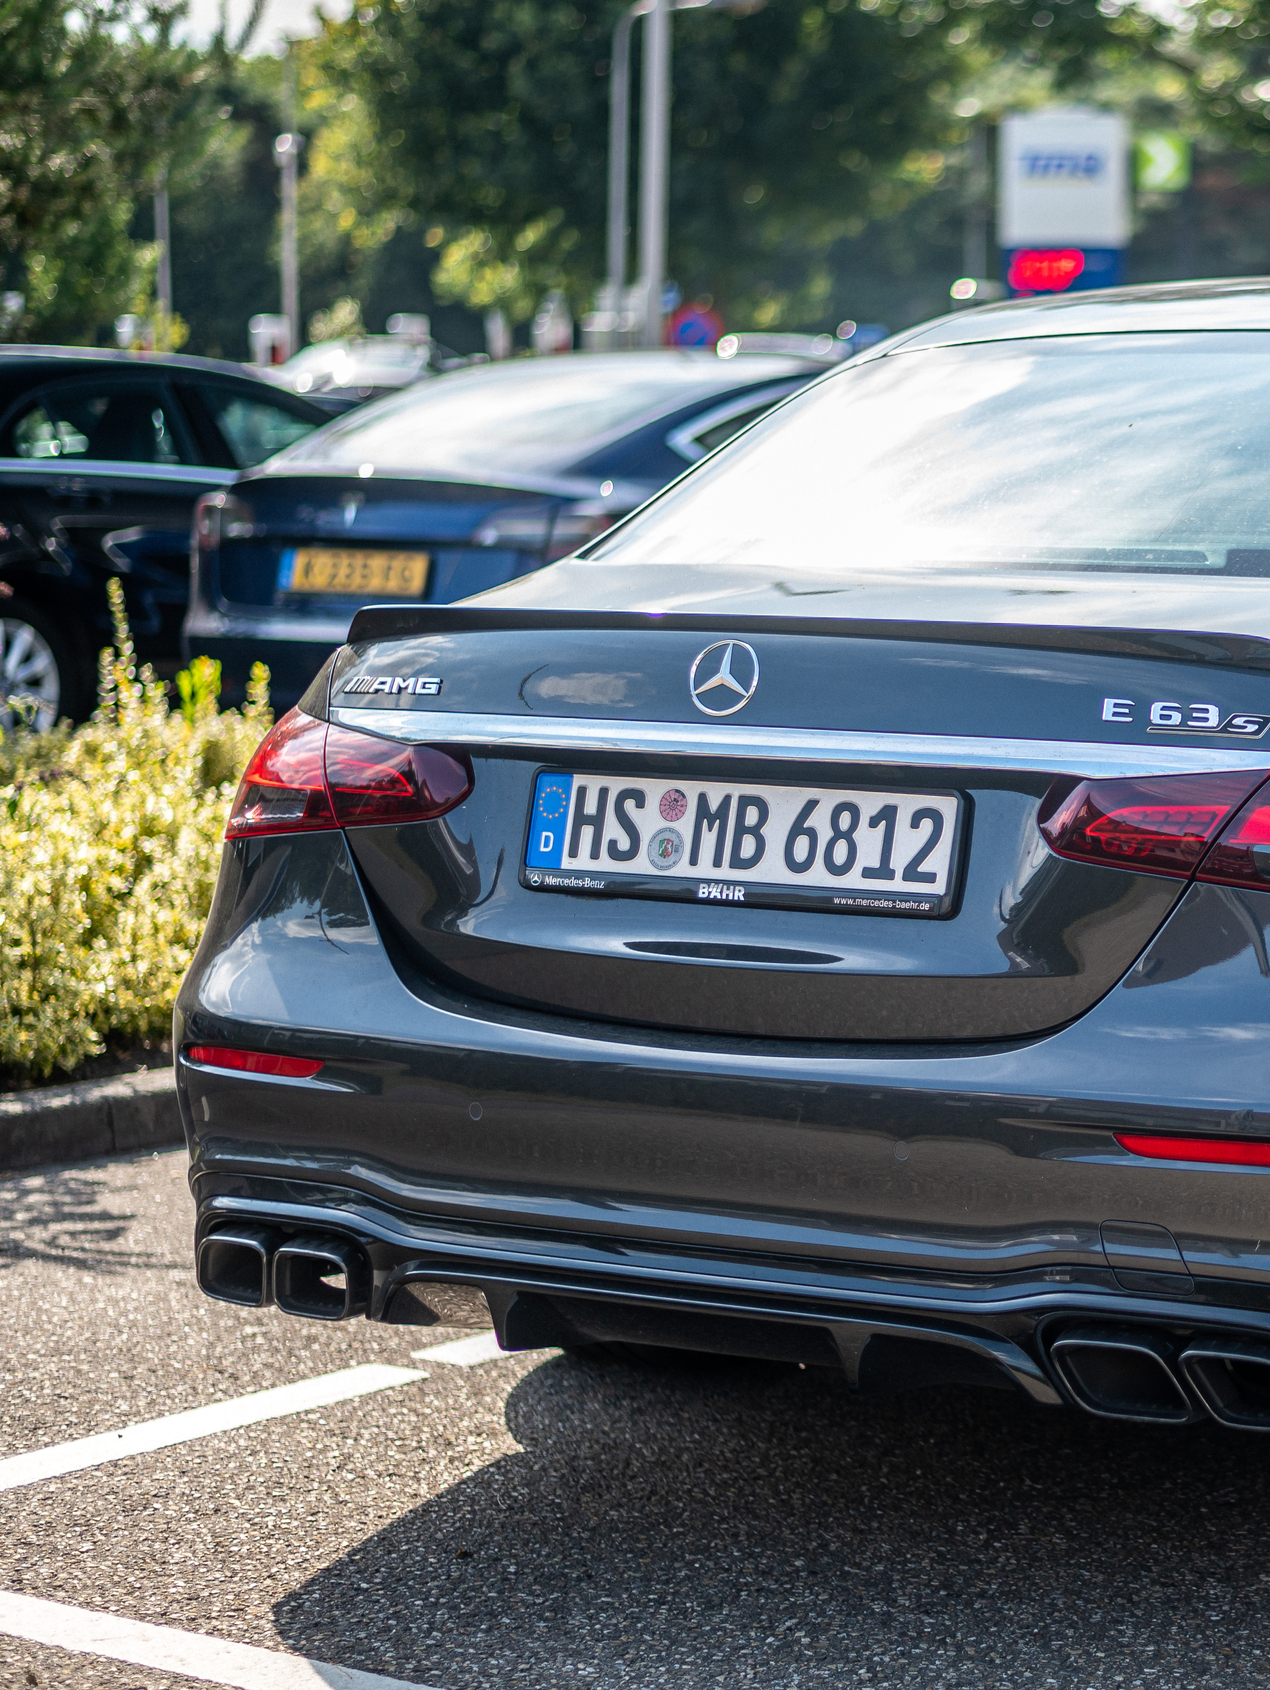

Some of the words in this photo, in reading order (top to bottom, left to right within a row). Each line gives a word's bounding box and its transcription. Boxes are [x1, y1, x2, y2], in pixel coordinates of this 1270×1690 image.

[369, 677, 442, 695] AMG
[1102, 698, 1136, 722] E
[540, 832, 554, 852] D
[568, 785, 646, 862] HS
[689, 792, 769, 870] MB
[784, 798, 944, 883] 6812
[544, 874, 605, 889] Mercedes-Benz
[833, 896, 930, 911] www.mercedes-baehr.de
